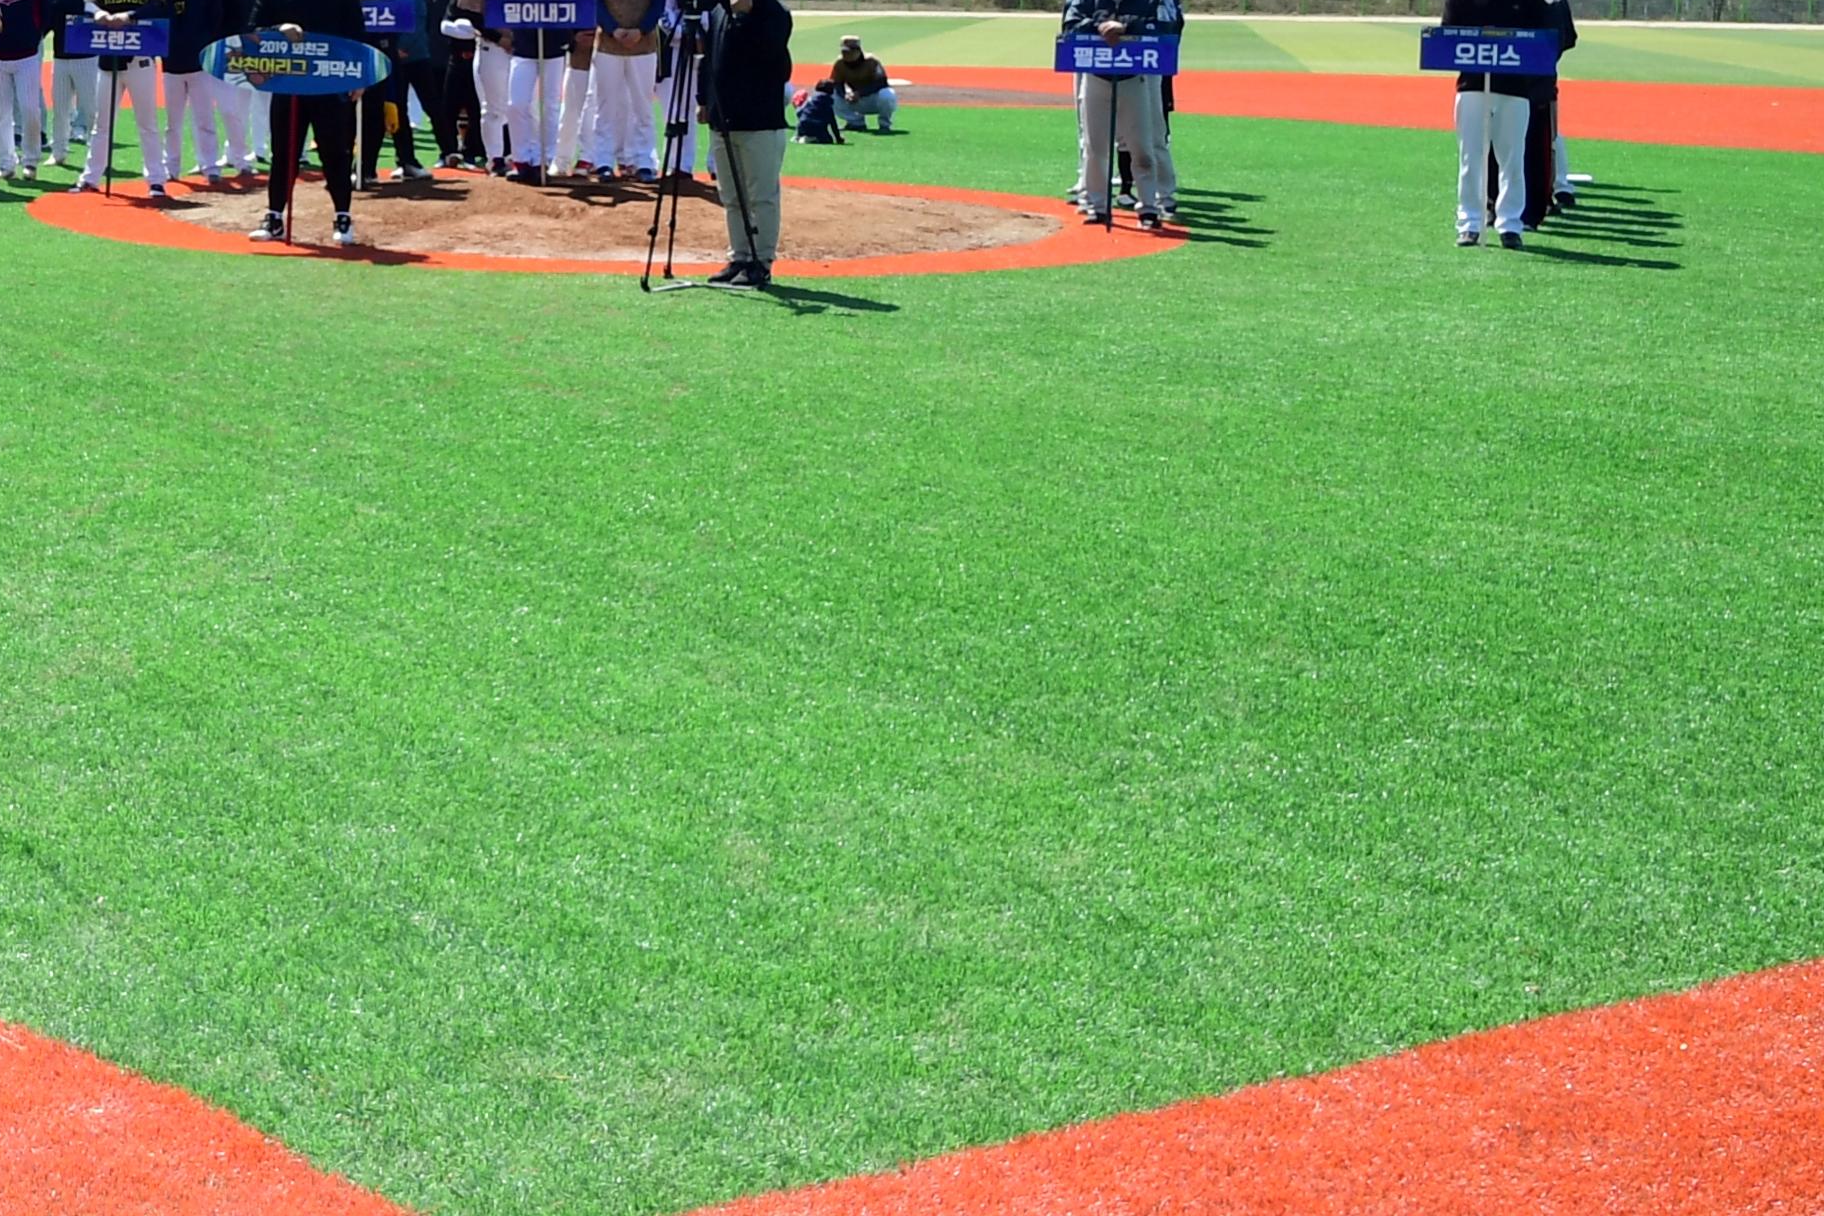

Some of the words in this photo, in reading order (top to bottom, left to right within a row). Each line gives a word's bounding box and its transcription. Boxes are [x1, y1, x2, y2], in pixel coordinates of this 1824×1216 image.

[504, 2, 576, 23] 밀어내기
[90, 30, 141, 50] 프렌즈
[259, 41, 288, 54] 2019
[291, 42, 329, 56] 화천군
[1454, 43, 1521, 66] 오터스
[228, 57, 308, 75] 산천어리그
[312, 60, 363, 79] 개막식
